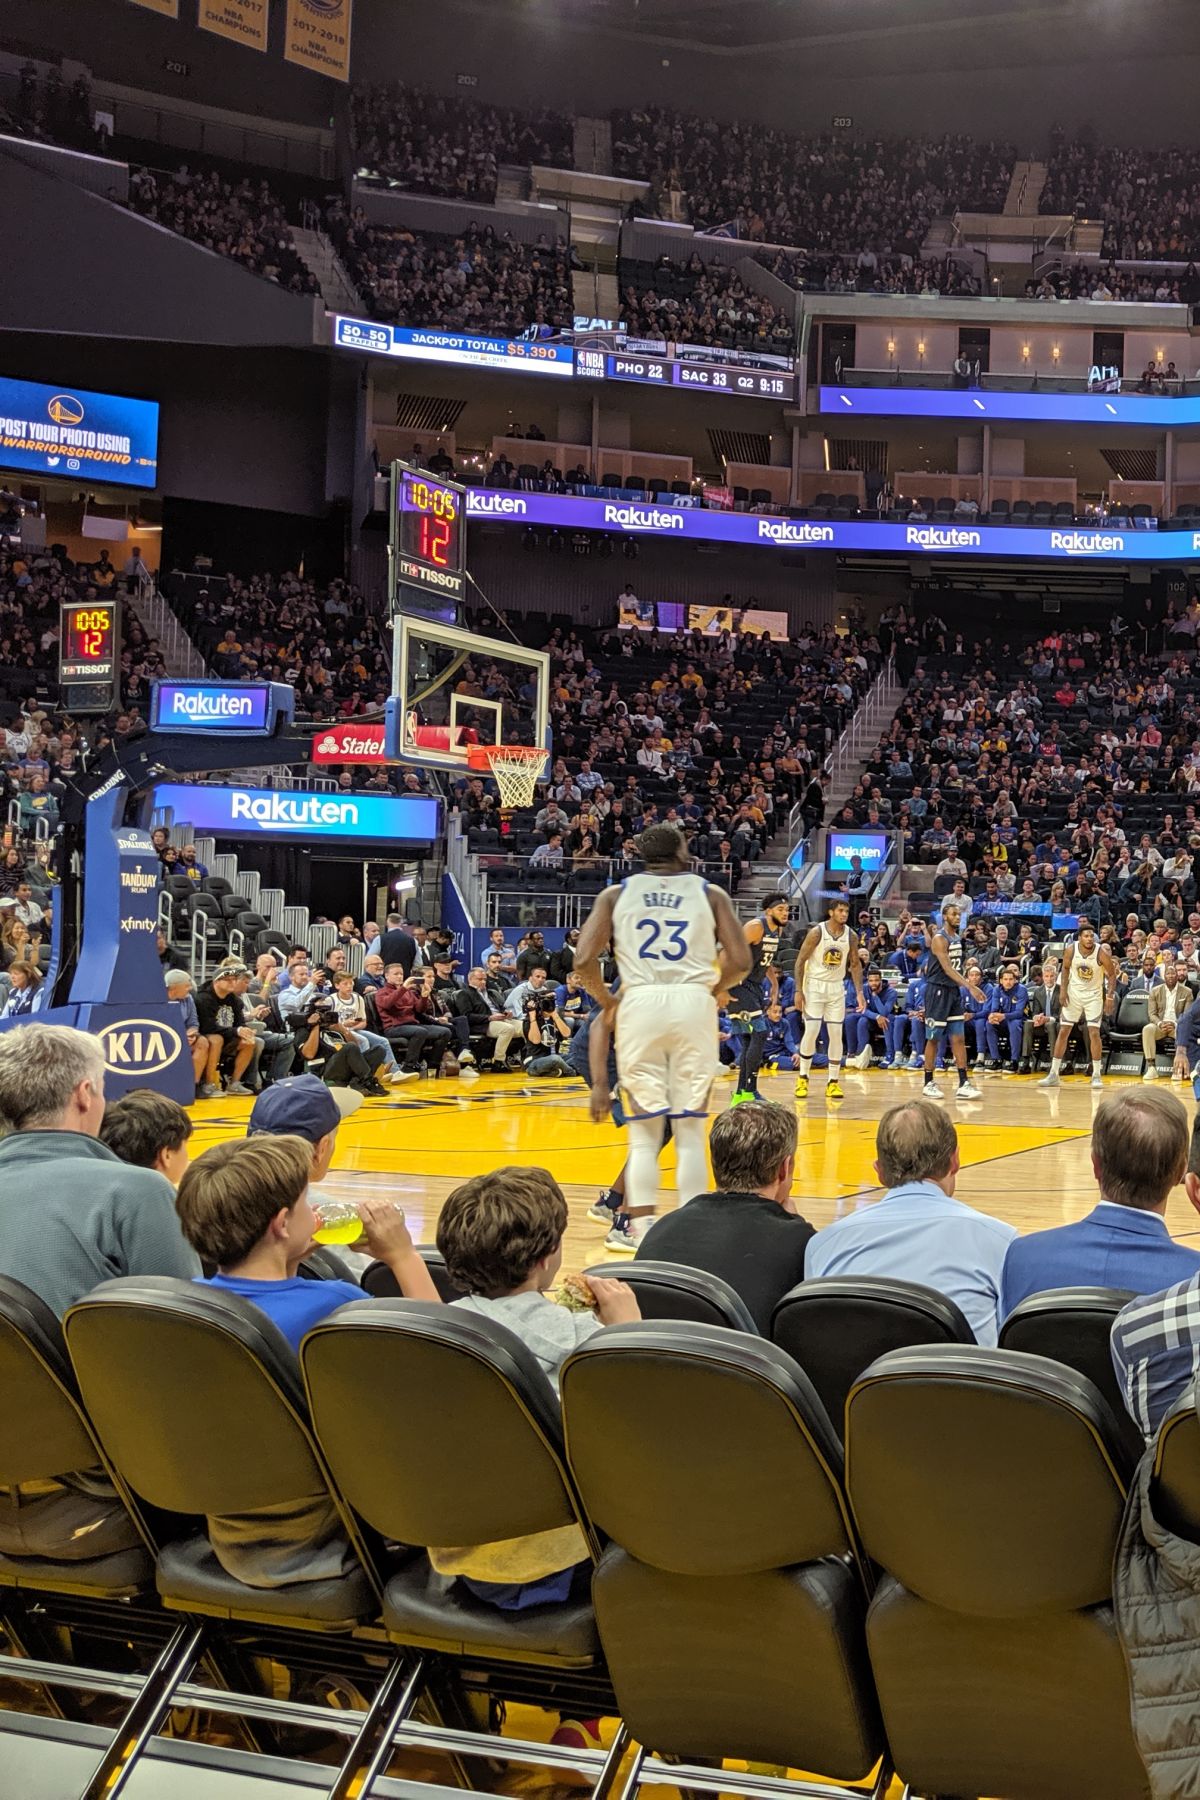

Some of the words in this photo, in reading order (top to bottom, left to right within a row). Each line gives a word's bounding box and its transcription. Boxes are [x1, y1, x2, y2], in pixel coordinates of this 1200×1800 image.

[223, 7, 244, 21] NBA
[204, 10, 262, 38] CHAMPIONS
[292, 18, 345, 45] 2017-2018
[291, 43, 344, 69] CHAMPIONS
[307, 40, 327, 54] NBA
[166, 60, 187, 75] 201
[457, 75, 478, 86] 202
[833, 117, 851, 127] 203
[343, 325, 361, 337] 50
[369, 331, 387, 342] 50
[411, 334, 464, 349] JACKPOT
[466, 340, 505, 353] TOTAL:
[507, 342, 557, 360] $5,390
[586, 351, 604, 368] NBA
[576, 367, 604, 377] SCORES
[616, 361, 644, 374] PHO
[648, 365, 663, 378] 22
[682, 370, 708, 383] SAC
[713, 373, 727, 387] 33
[737, 377, 754, 388] Q2
[760, 378, 784, 393] 9:15
[0, 418, 27, 437] POST
[29, 422, 58, 442] YOUR
[60, 428, 96, 448] PHOTO
[97, 433, 130, 454] USING
[412, 483, 455, 520] 10:05
[466, 491, 527, 514] kuten
[605, 506, 684, 528] Rakuten
[758, 520, 834, 541] Rakuten
[907, 527, 981, 545] Rakuten
[422, 517, 449, 564] 12
[1051, 532, 1124, 551] Rakuten
[418, 567, 462, 591] TISSOT
[1168, 582, 1186, 592] 102
[76, 611, 109, 631] 10:05
[85, 632, 102, 656] 12
[76, 664, 111, 675] TISSOT
[173, 692, 252, 715] Rakuten
[88, 769, 126, 801] SPALDING
[231, 792, 359, 825] Rakuten
[117, 839, 153, 851] SPALDING
[835, 846, 881, 858] Rakuten
[121, 873, 157, 888] TANDUAY
[642, 892, 684, 910] GREEN
[121, 916, 157, 933] xfinity
[636, 919, 689, 961] 23
[109, 1031, 167, 1063] KIA
[1110, 1064, 1140, 1072] BIOFREEZE
